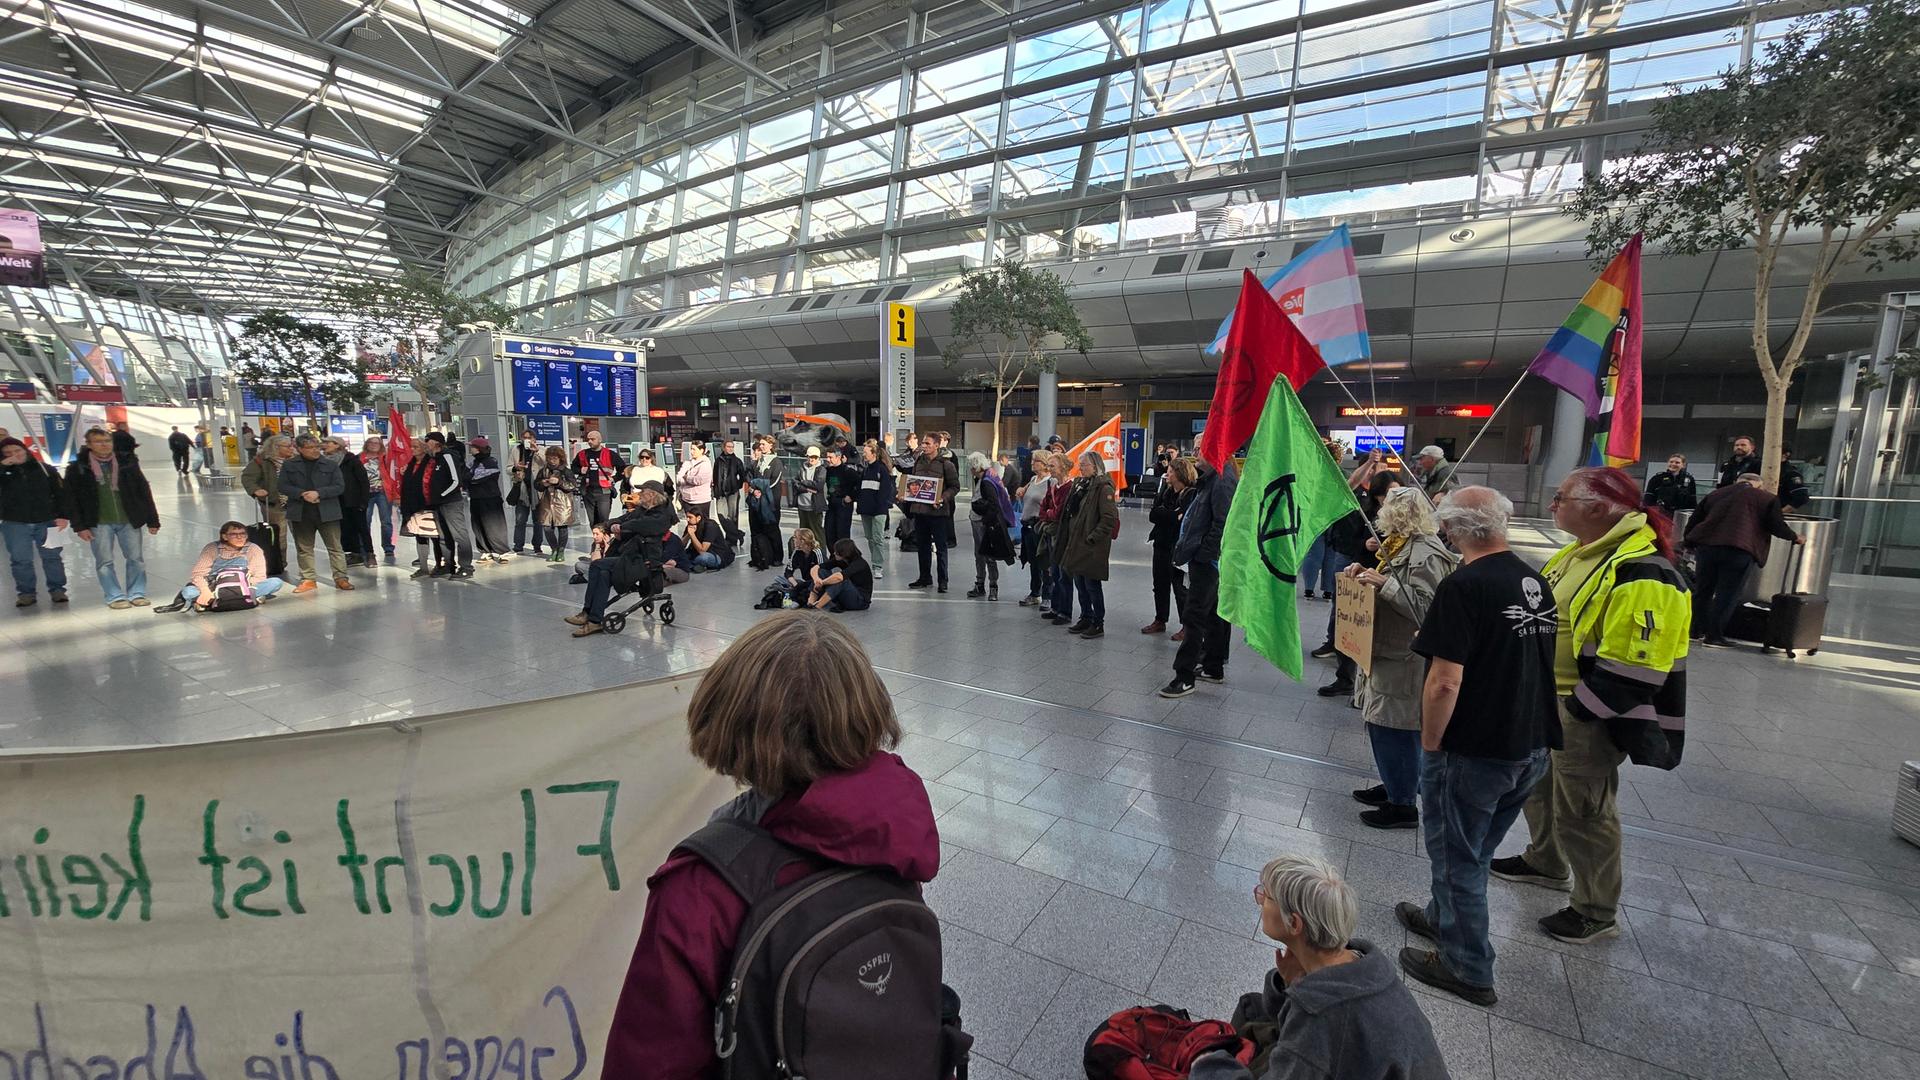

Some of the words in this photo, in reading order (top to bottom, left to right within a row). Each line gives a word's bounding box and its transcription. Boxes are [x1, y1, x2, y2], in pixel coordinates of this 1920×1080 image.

[0, 257, 32, 269] Welt
[898, 352, 906, 423] Information
[1368, 407, 1403, 416] TICKETS
[55, 422, 66, 431] B
[858, 952, 891, 977] OSPREY
